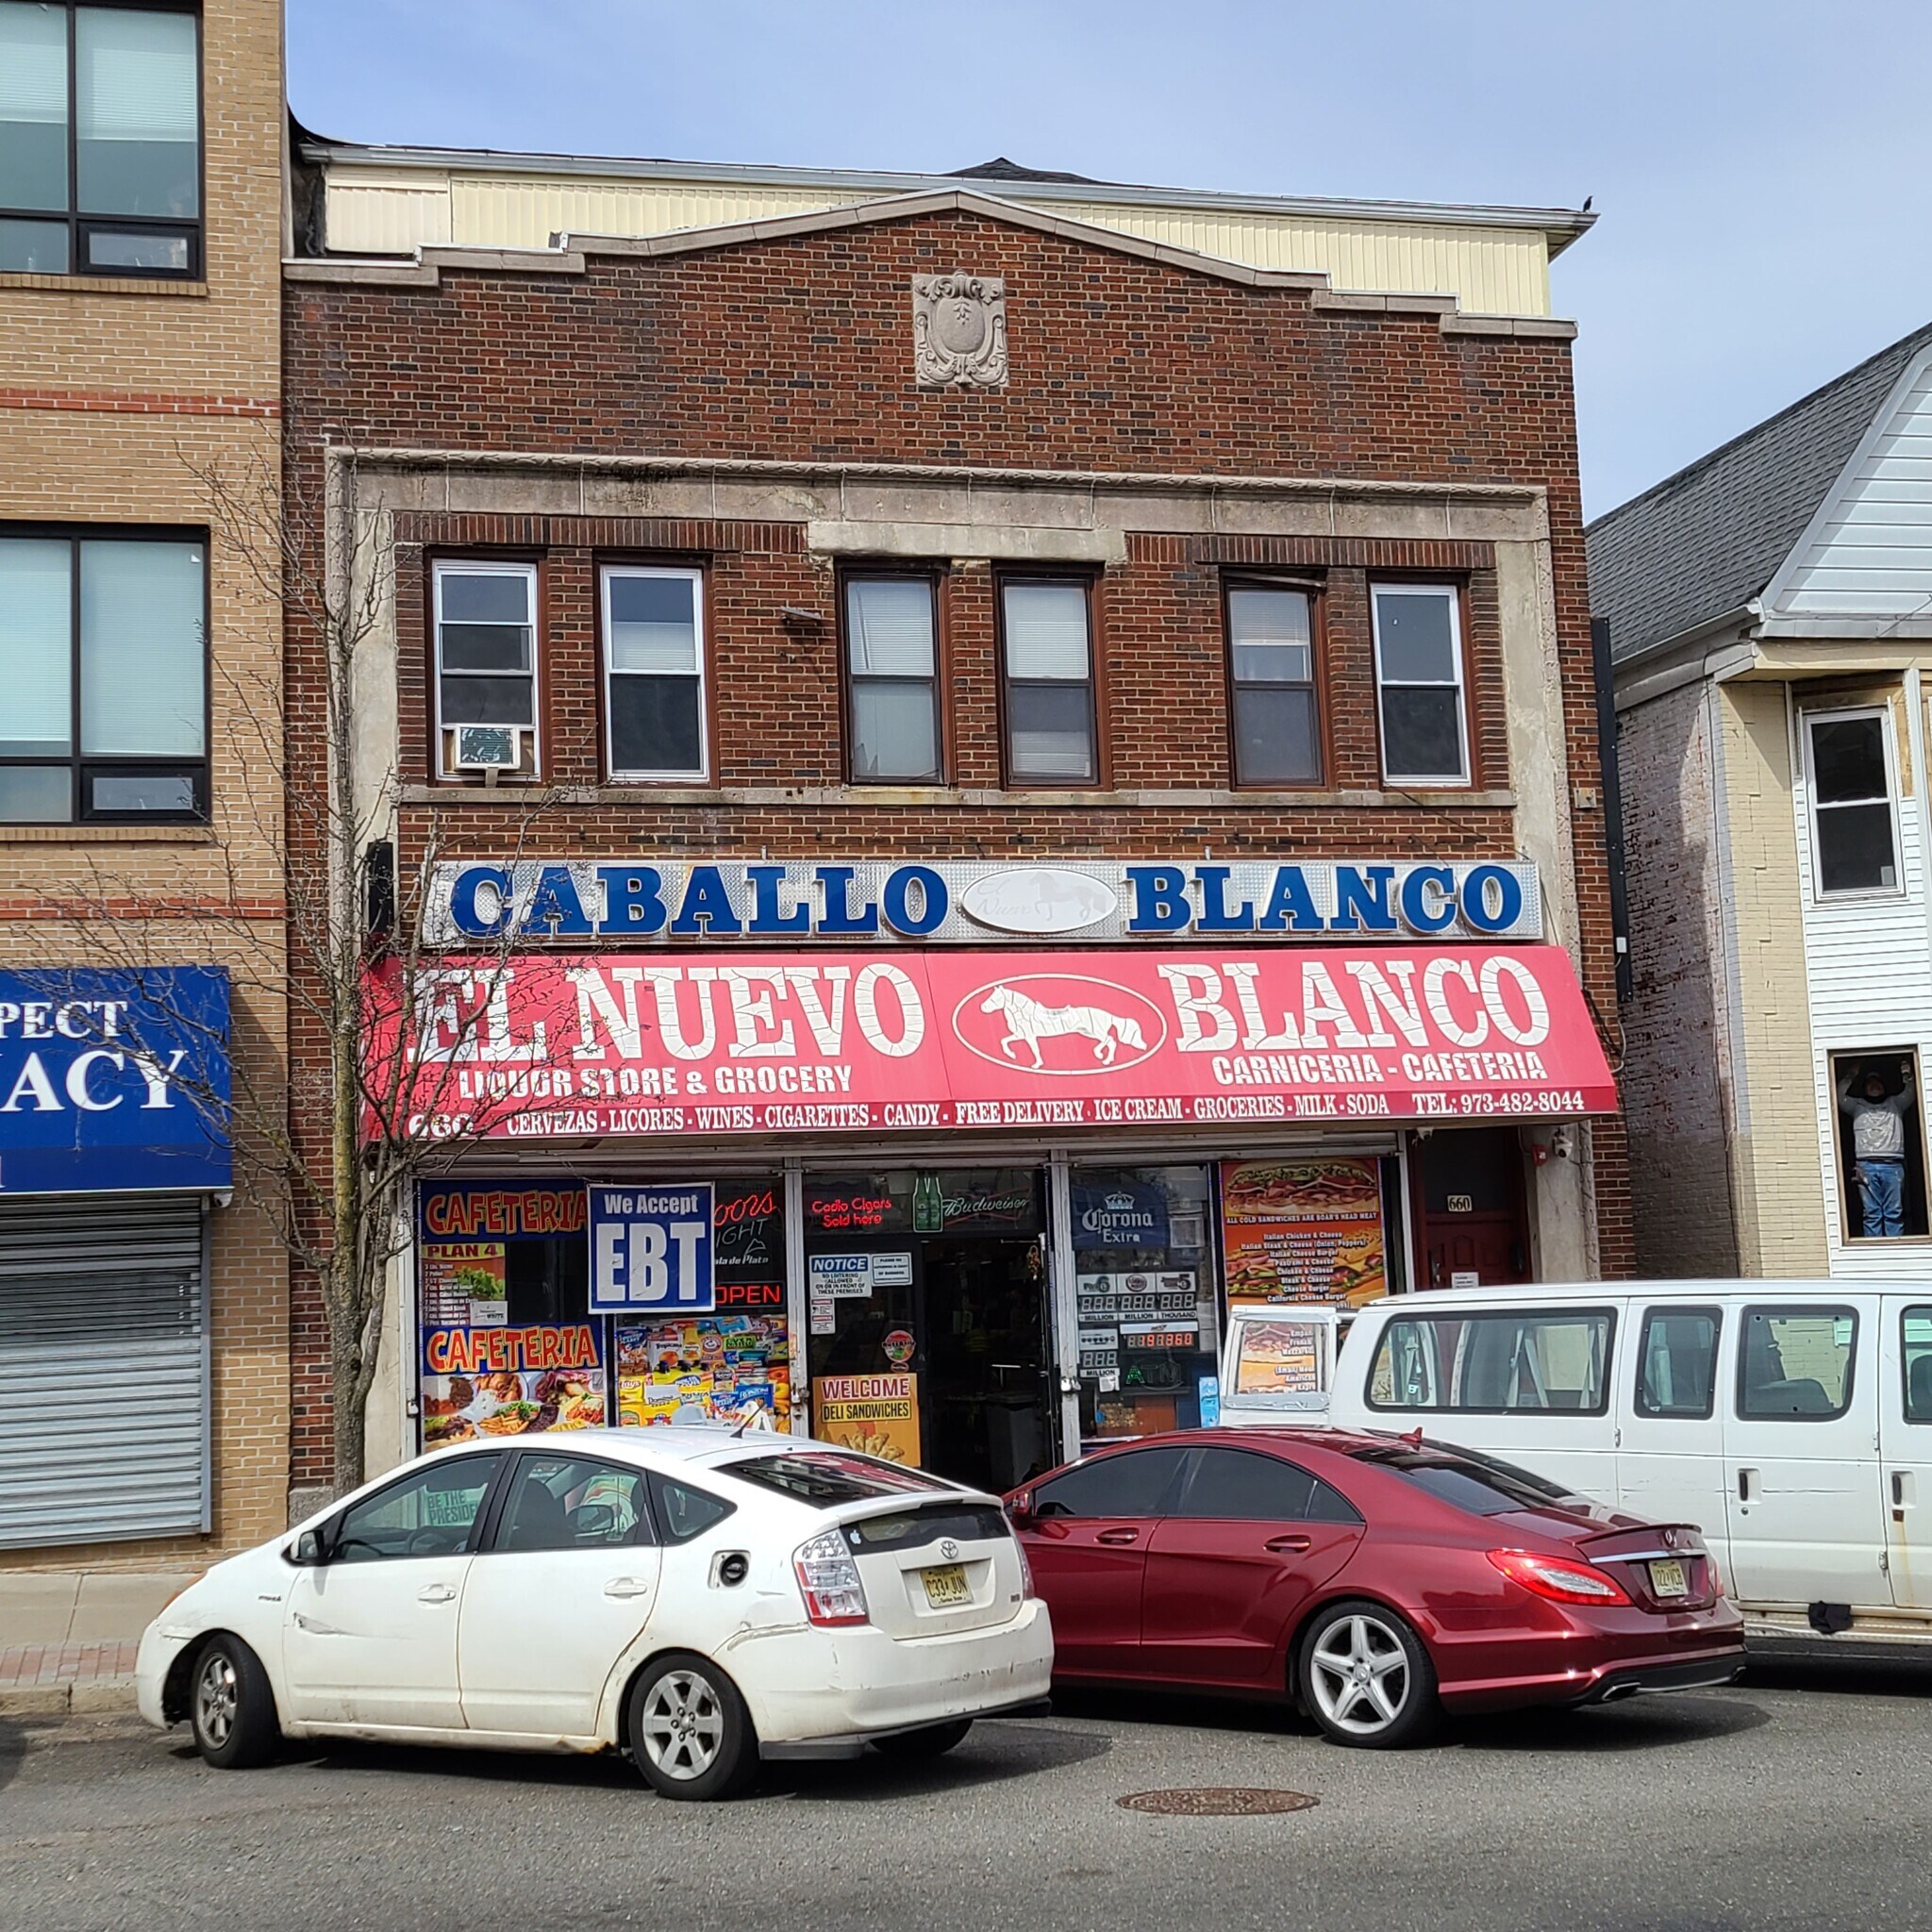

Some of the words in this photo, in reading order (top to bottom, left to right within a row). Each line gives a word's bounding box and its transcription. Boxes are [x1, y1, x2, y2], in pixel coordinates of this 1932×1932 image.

[450, 864, 950, 937] CABALLO
[1125, 864, 1523, 933] BLANCO
[406, 964, 547, 1064] EL
[567, 960, 927, 1062] NUEVO
[1157, 955, 1549, 1053] BLANCO
[0, 1049, 190, 1112] ACY
[1211, 1055, 1386, 1086] CARNICERIA
[1400, 1051, 1550, 1083] CAFETERIA
[458, 1069, 574, 1102] LIQUOR
[579, 1065, 679, 1097] STORE
[715, 1064, 852, 1095] GROCERY
[507, 1109, 598, 1136] CERVEZAS
[608, 1107, 685, 1132] LICORES
[694, 1105, 754, 1130] WINES
[764, 1104, 870, 1129] CIGARETTES
[883, 1103, 941, 1126] CANDY
[955, 1101, 1002, 1125] FREE
[1003, 1099, 1084, 1124] DELIVERY
[1094, 1098, 1123, 1121] ICE
[1124, 1097, 1183, 1121] CREAM
[1193, 1095, 1285, 1120] GROCERIES
[1294, 1094, 1335, 1117] MILK
[1346, 1093, 1390, 1115] SODA
[1413, 1091, 1458, 1115] TEL:
[1461, 1091, 1585, 1114] 973-482-8044
[425, 1190, 588, 1236] CAFETERIA
[604, 1193, 634, 1214] We
[636, 1193, 699, 1216] Accept
[714, 1191, 777, 1226] oors
[942, 1196, 1031, 1216] Budweiser
[1449, 1197, 1471, 1211] 660
[715, 1217, 769, 1248] IGHT
[823, 1214, 850, 1228] Sold
[1082, 1208, 1154, 1234] Corona
[1103, 1228, 1141, 1243] Extra
[426, 1244, 479, 1258] PLAN
[484, 1243, 499, 1256] 4
[595, 1222, 706, 1302] EBT
[813, 1257, 867, 1272] NOTICE
[715, 1285, 780, 1305] OPEN
[426, 1324, 600, 1374] CAFETERIA
[822, 1377, 910, 1400] WELCOME
[824, 1405, 844, 1420] DELI
[846, 1402, 909, 1420] SANDWICHES
[427, 1494, 441, 1508] BE
[444, 1491, 466, 1507] THE
[429, 1503, 478, 1525] PRESIDE
